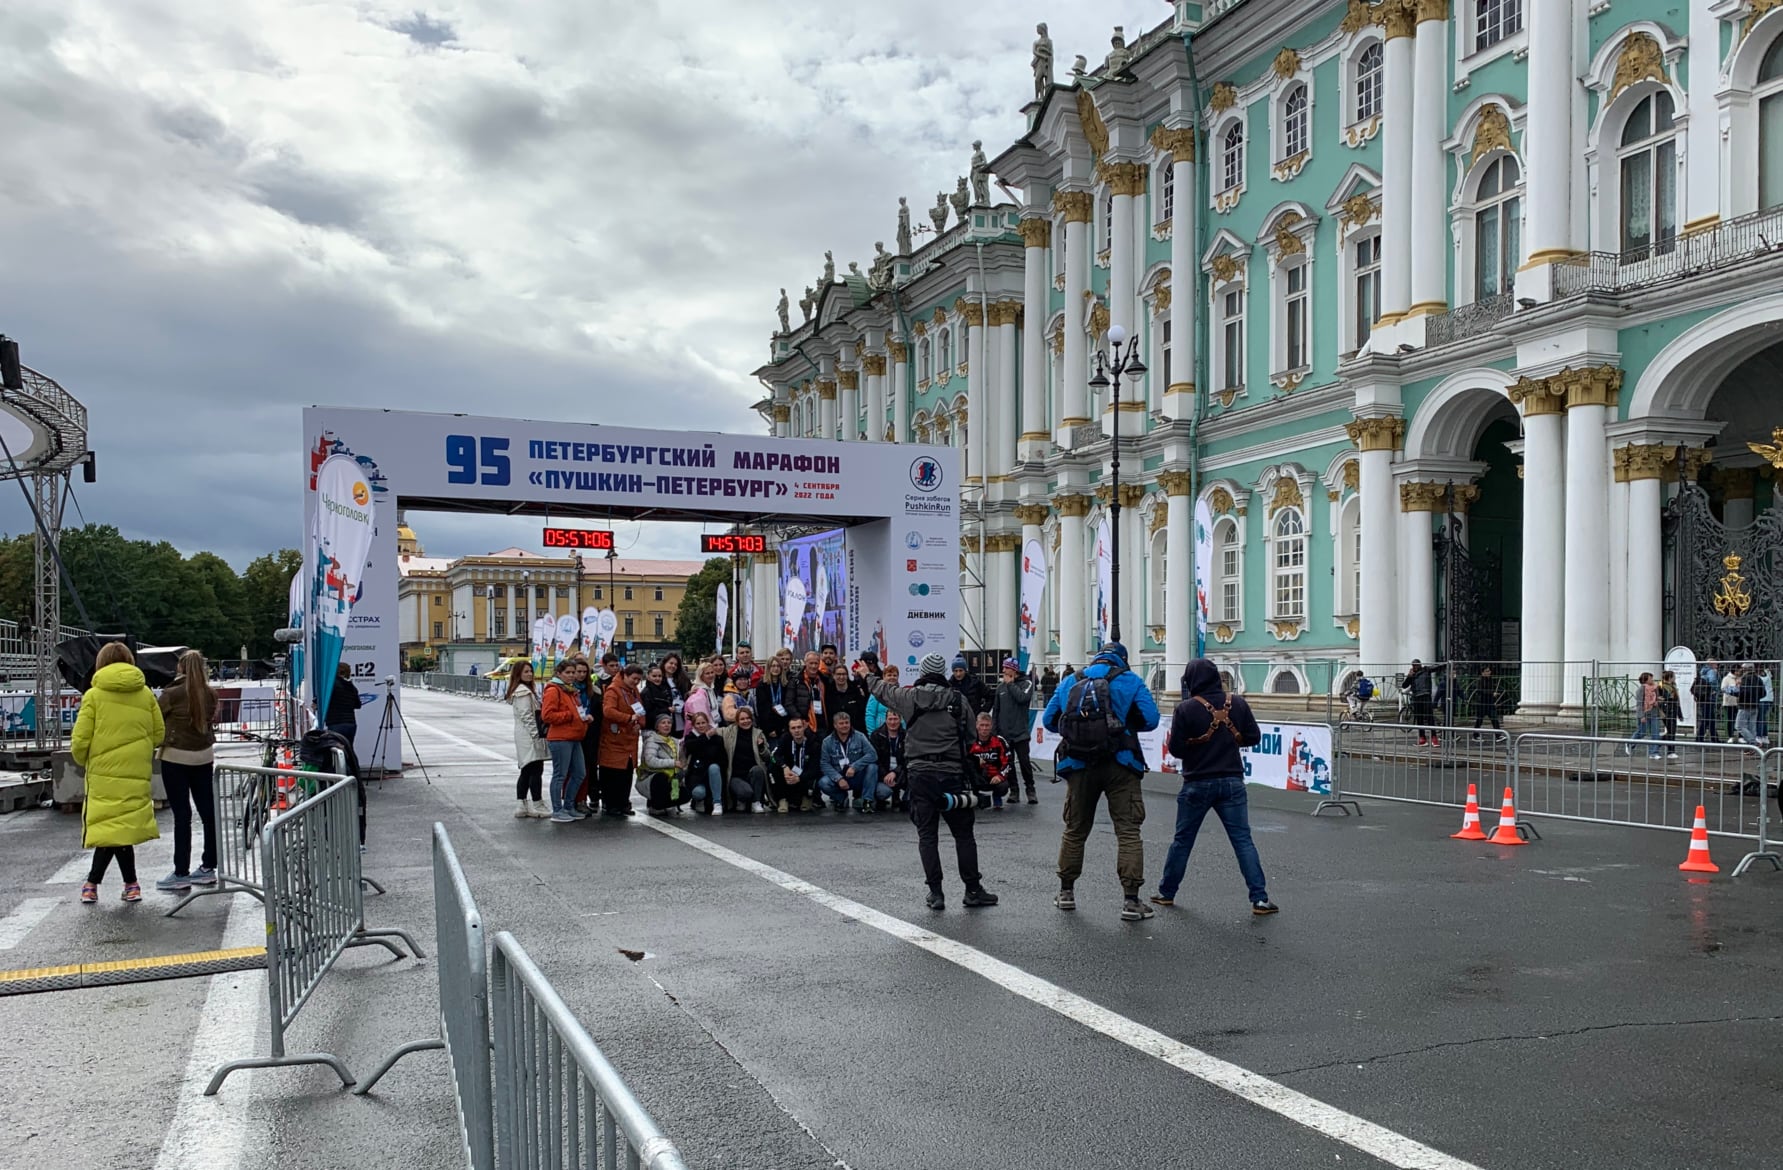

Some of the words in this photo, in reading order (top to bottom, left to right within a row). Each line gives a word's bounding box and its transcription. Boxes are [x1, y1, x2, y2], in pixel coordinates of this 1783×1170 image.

[446, 434, 511, 486] 95
[529, 439, 715, 468] ПЕТЕРБУРГСКИЙ
[733, 451, 840, 473] МАРАФОН
[803, 482, 840, 490] СЕНТЯБРЯ
[794, 491, 812, 499] 2022
[905, 501, 951, 511] PushkinRun
[545, 529, 612, 549] 05:57:06
[707, 536, 763, 552] 14:57:03
[907, 611, 946, 619] ДНЕВНИК
